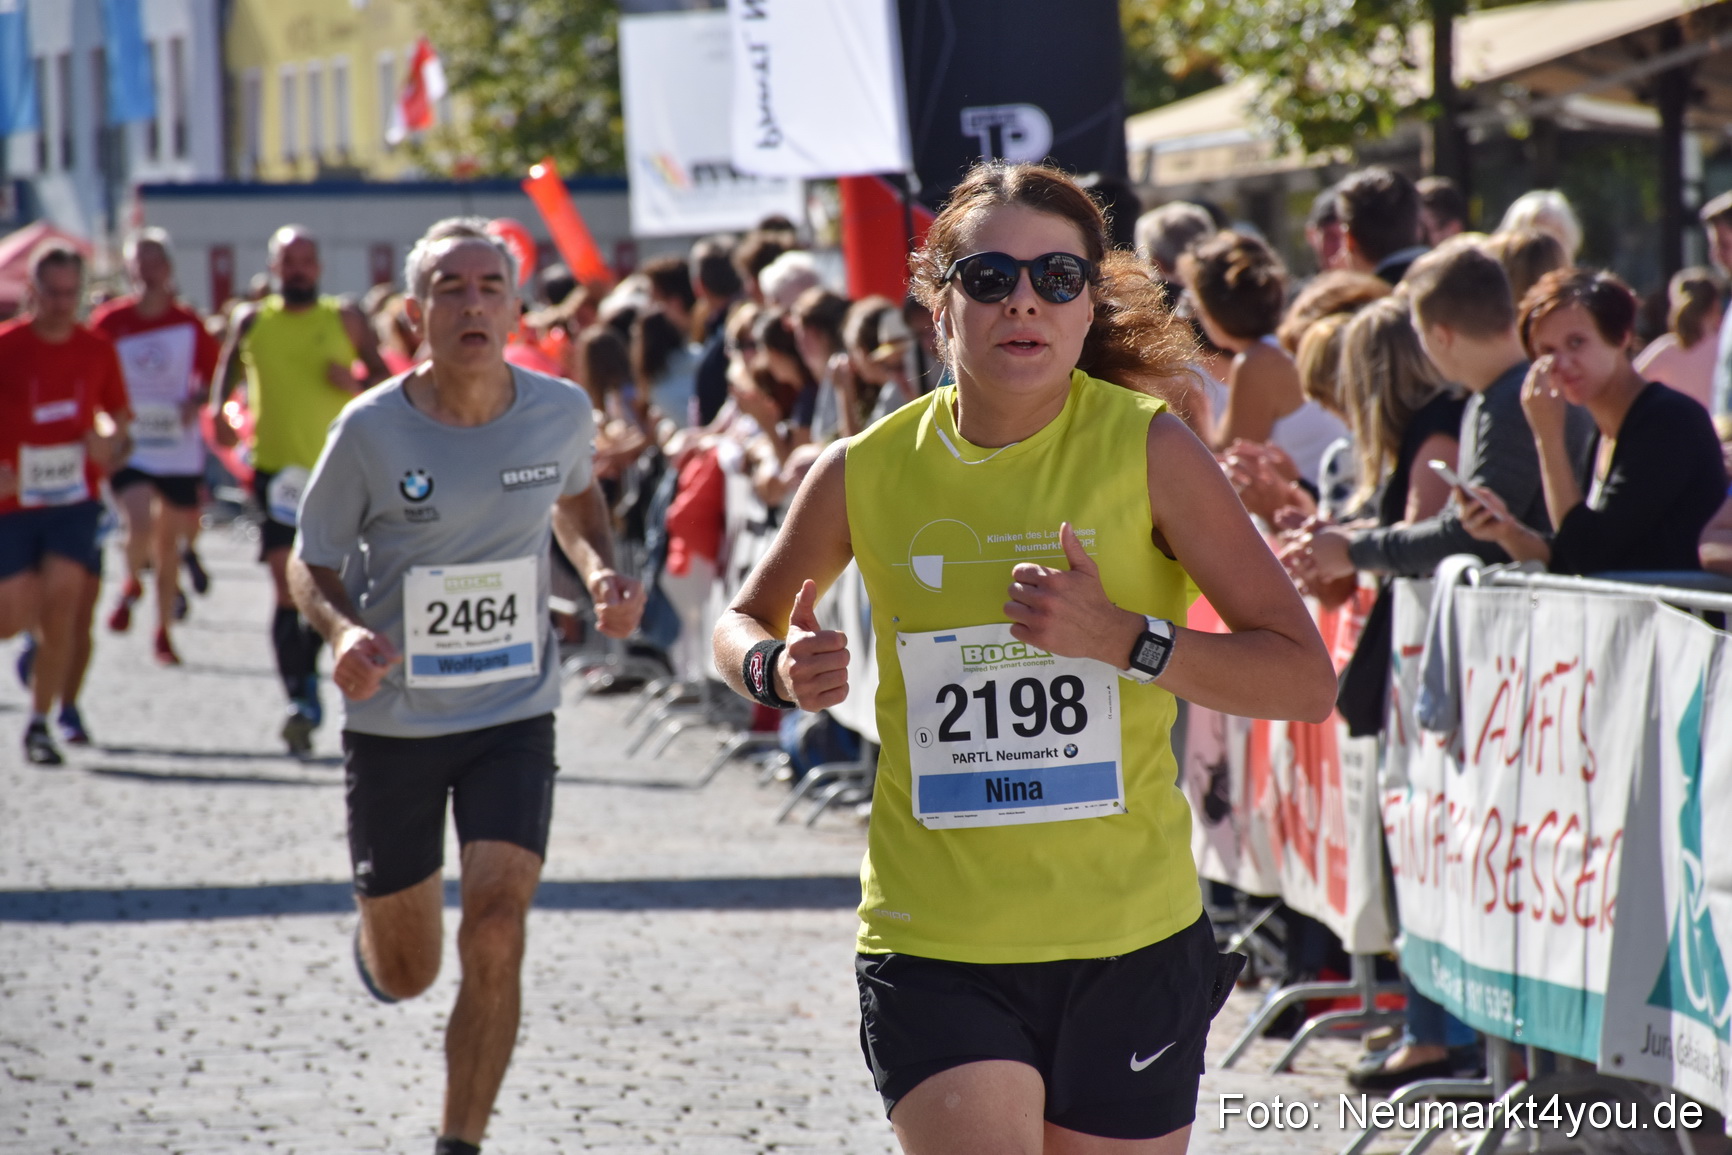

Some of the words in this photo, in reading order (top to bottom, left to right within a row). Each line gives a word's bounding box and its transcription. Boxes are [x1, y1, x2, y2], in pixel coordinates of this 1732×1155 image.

[501, 463, 559, 488] BOCK
[987, 533, 1023, 543] Kliniken
[1026, 531, 1042, 539] des
[1044, 528, 1096, 539] Laneises
[1015, 542, 1061, 552] Neumarkt
[427, 593, 518, 636] 2464
[437, 653, 510, 674] Wolfgang
[961, 642, 1053, 664] BOCK
[963, 665, 988, 674] inspired
[1022, 659, 1056, 668] concepts
[935, 674, 1088, 742] 2198
[920, 732, 928, 743] D
[952, 751, 993, 764] PARTL
[996, 747, 1059, 761] Neumarkt
[985, 777, 1044, 803] Nina
[1472, 808, 1623, 932] BESSER
